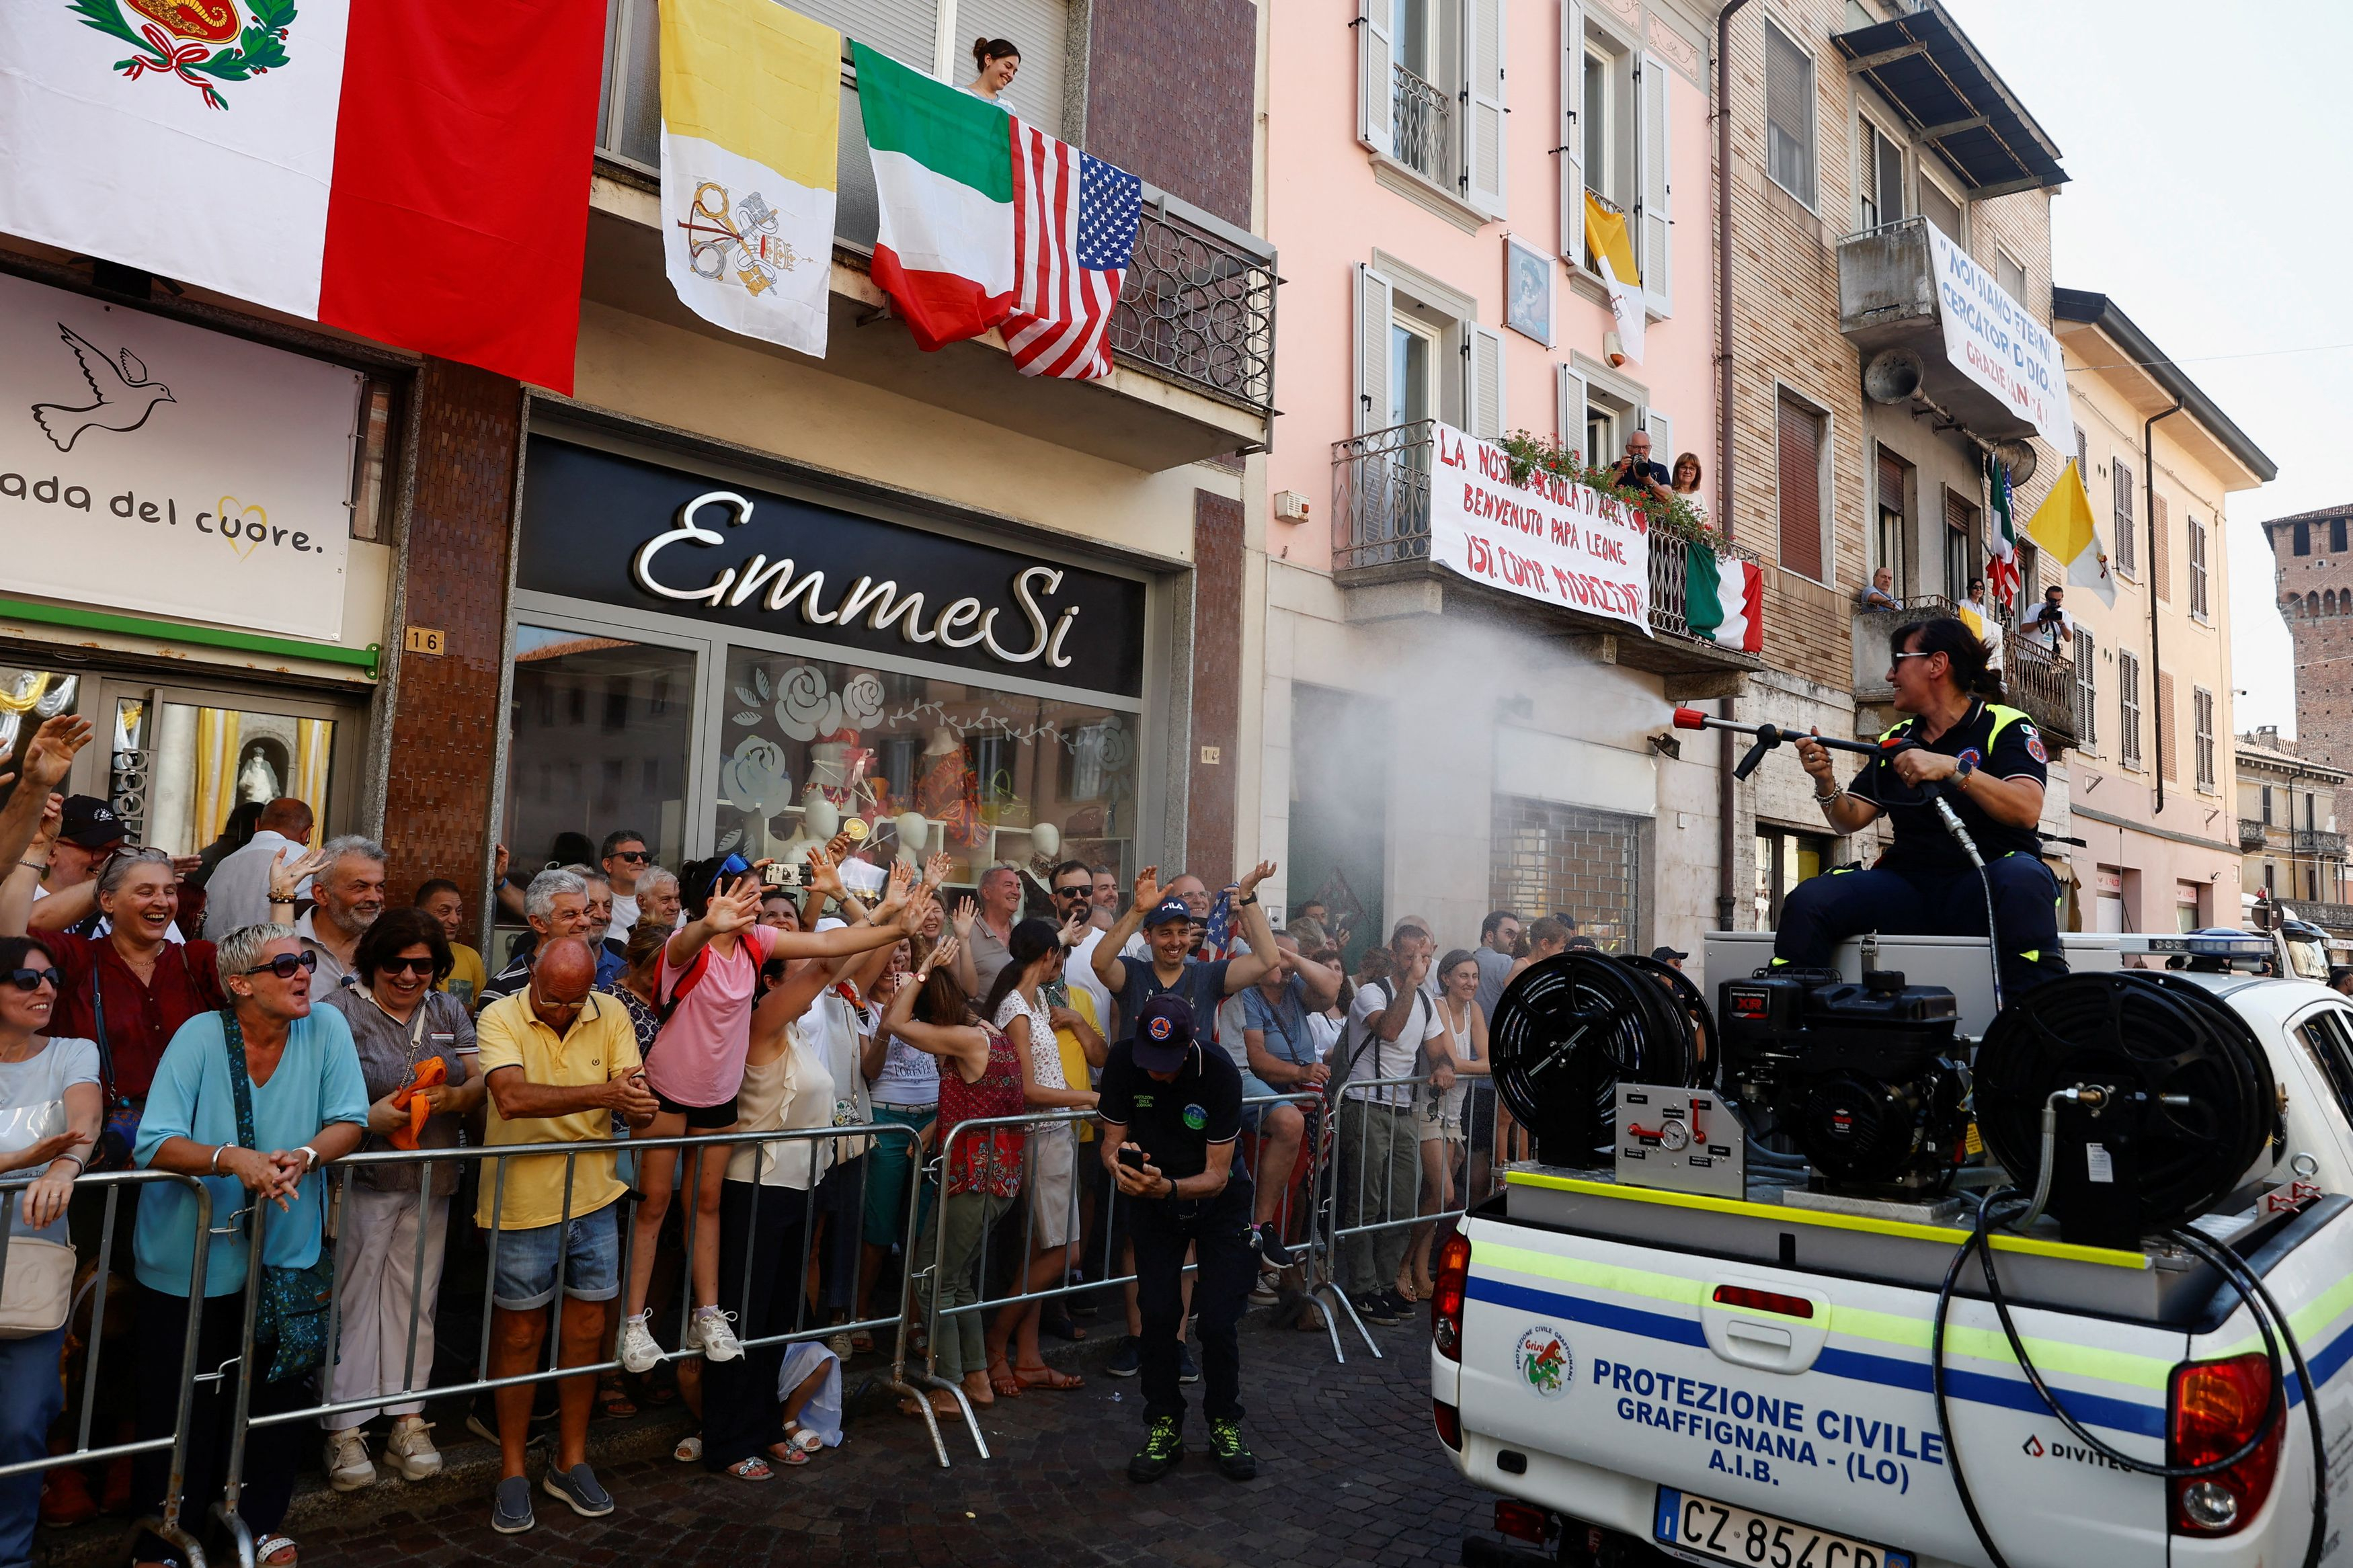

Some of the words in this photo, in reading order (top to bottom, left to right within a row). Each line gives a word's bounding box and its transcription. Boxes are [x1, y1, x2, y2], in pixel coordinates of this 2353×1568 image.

[1942, 282, 2011, 360] CERCATORI
[1978, 274, 2011, 325] SIAMO
[2014, 312, 2050, 363] ETERNI
[1966, 340, 2005, 390] GRAZIE
[1441, 428, 1466, 470] LA
[1479, 444, 1525, 491] NOST
[1583, 489, 1593, 515] TI
[1598, 498, 1624, 527] APRE
[1626, 508, 1637, 531] IL
[110, 491, 176, 525] del
[196, 512, 323, 554] cuore.
[1464, 483, 1544, 537] BENVENUTO
[1551, 518, 1579, 550] PAPA
[1586, 530, 1627, 566] LEONE
[633, 491, 1080, 669] EmmeSi
[1464, 532, 1498, 579] IST.
[1498, 546, 1550, 593] COMP.
[1551, 565, 1644, 624] MORZENTI
[413, 632, 437, 650] 16
[1161, 902, 1184, 911] FILA
[1737, 997, 1762, 1010] XR
[894, 1060, 932, 1077] FOREVER
[1515, 1329, 1533, 1370] PROTEZIONE
[1535, 1326, 1552, 1334] CIVILE
[1554, 1331, 1574, 1382] GRAFFIGNANA
[1525, 1339, 1544, 1352] Grisù
[1593, 1358, 1804, 1433] PROTEZIONE
[1817, 1409, 1944, 1465] CIVILE
[1617, 1397, 1817, 1467] GRAFFIGNANA
[1845, 1451, 1909, 1495] (LO)
[1708, 1448, 1780, 1486] A.I.B.
